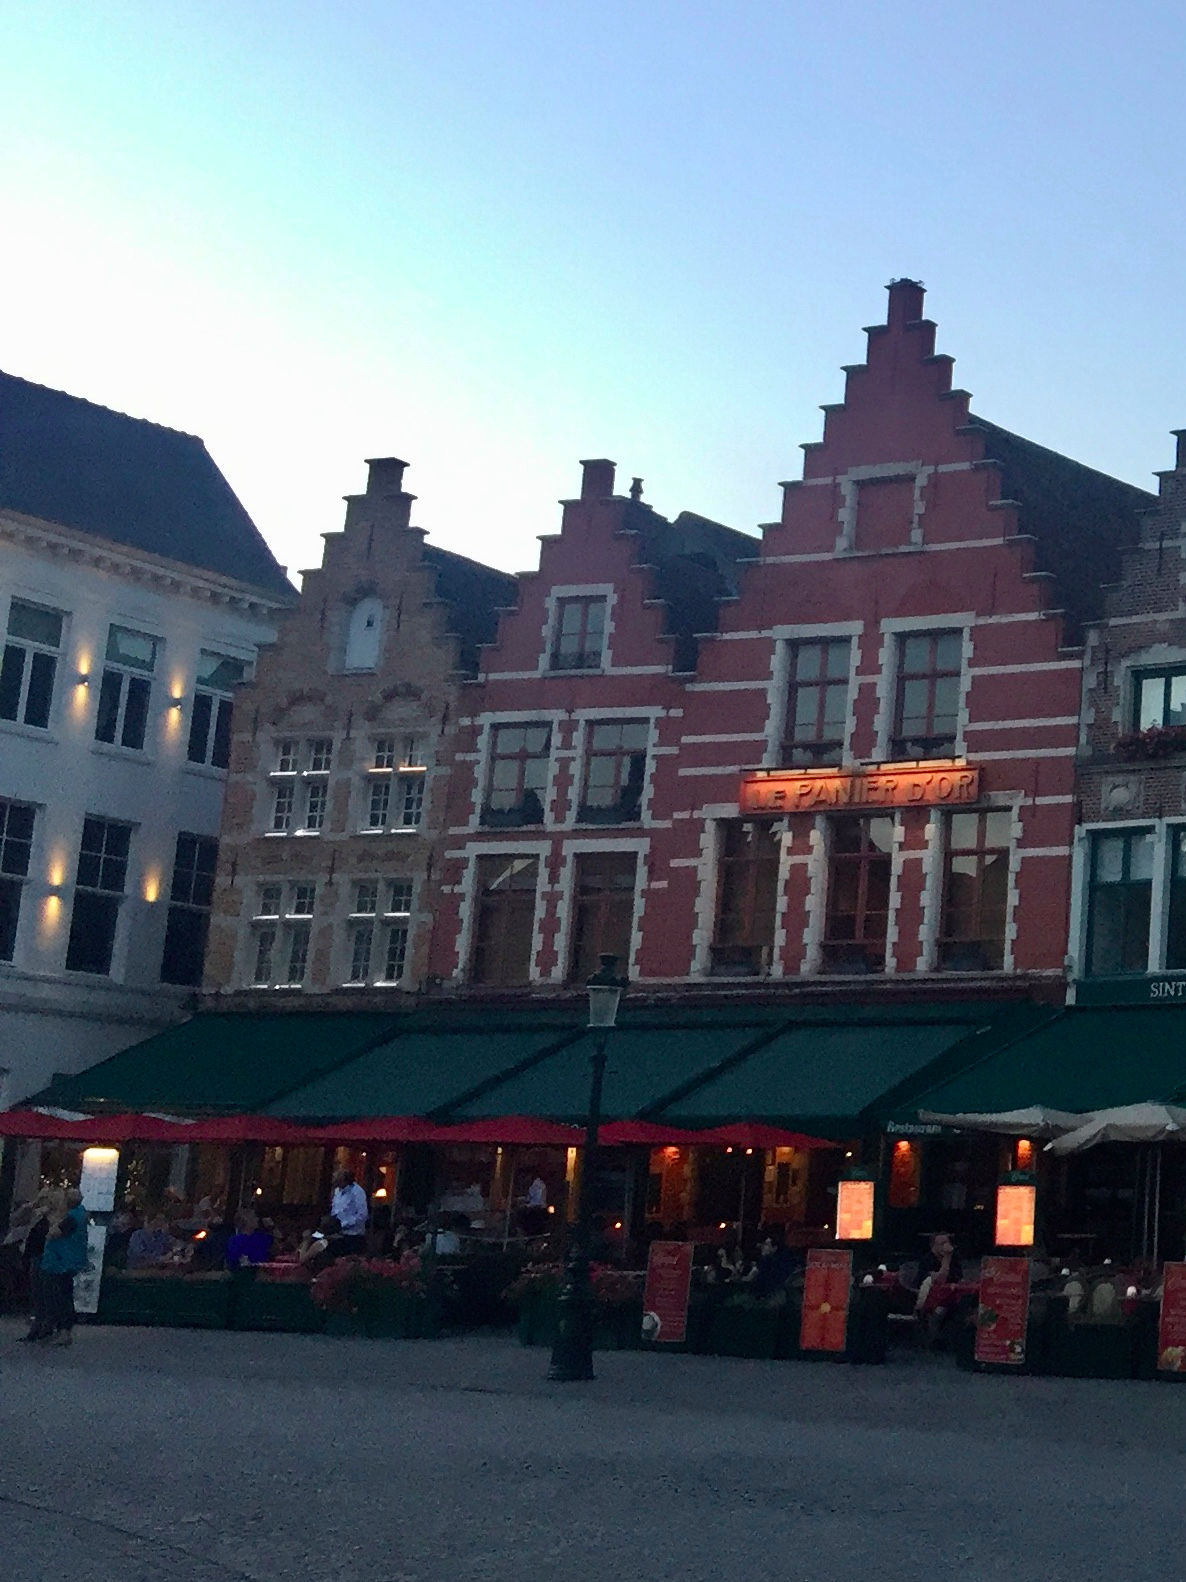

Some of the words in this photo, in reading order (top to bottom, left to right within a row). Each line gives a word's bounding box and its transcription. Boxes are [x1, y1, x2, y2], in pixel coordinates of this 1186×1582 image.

[794, 778, 898, 808] PANIER
[907, 775, 975, 803] D'OR
[1150, 981, 1186, 998] SINT
